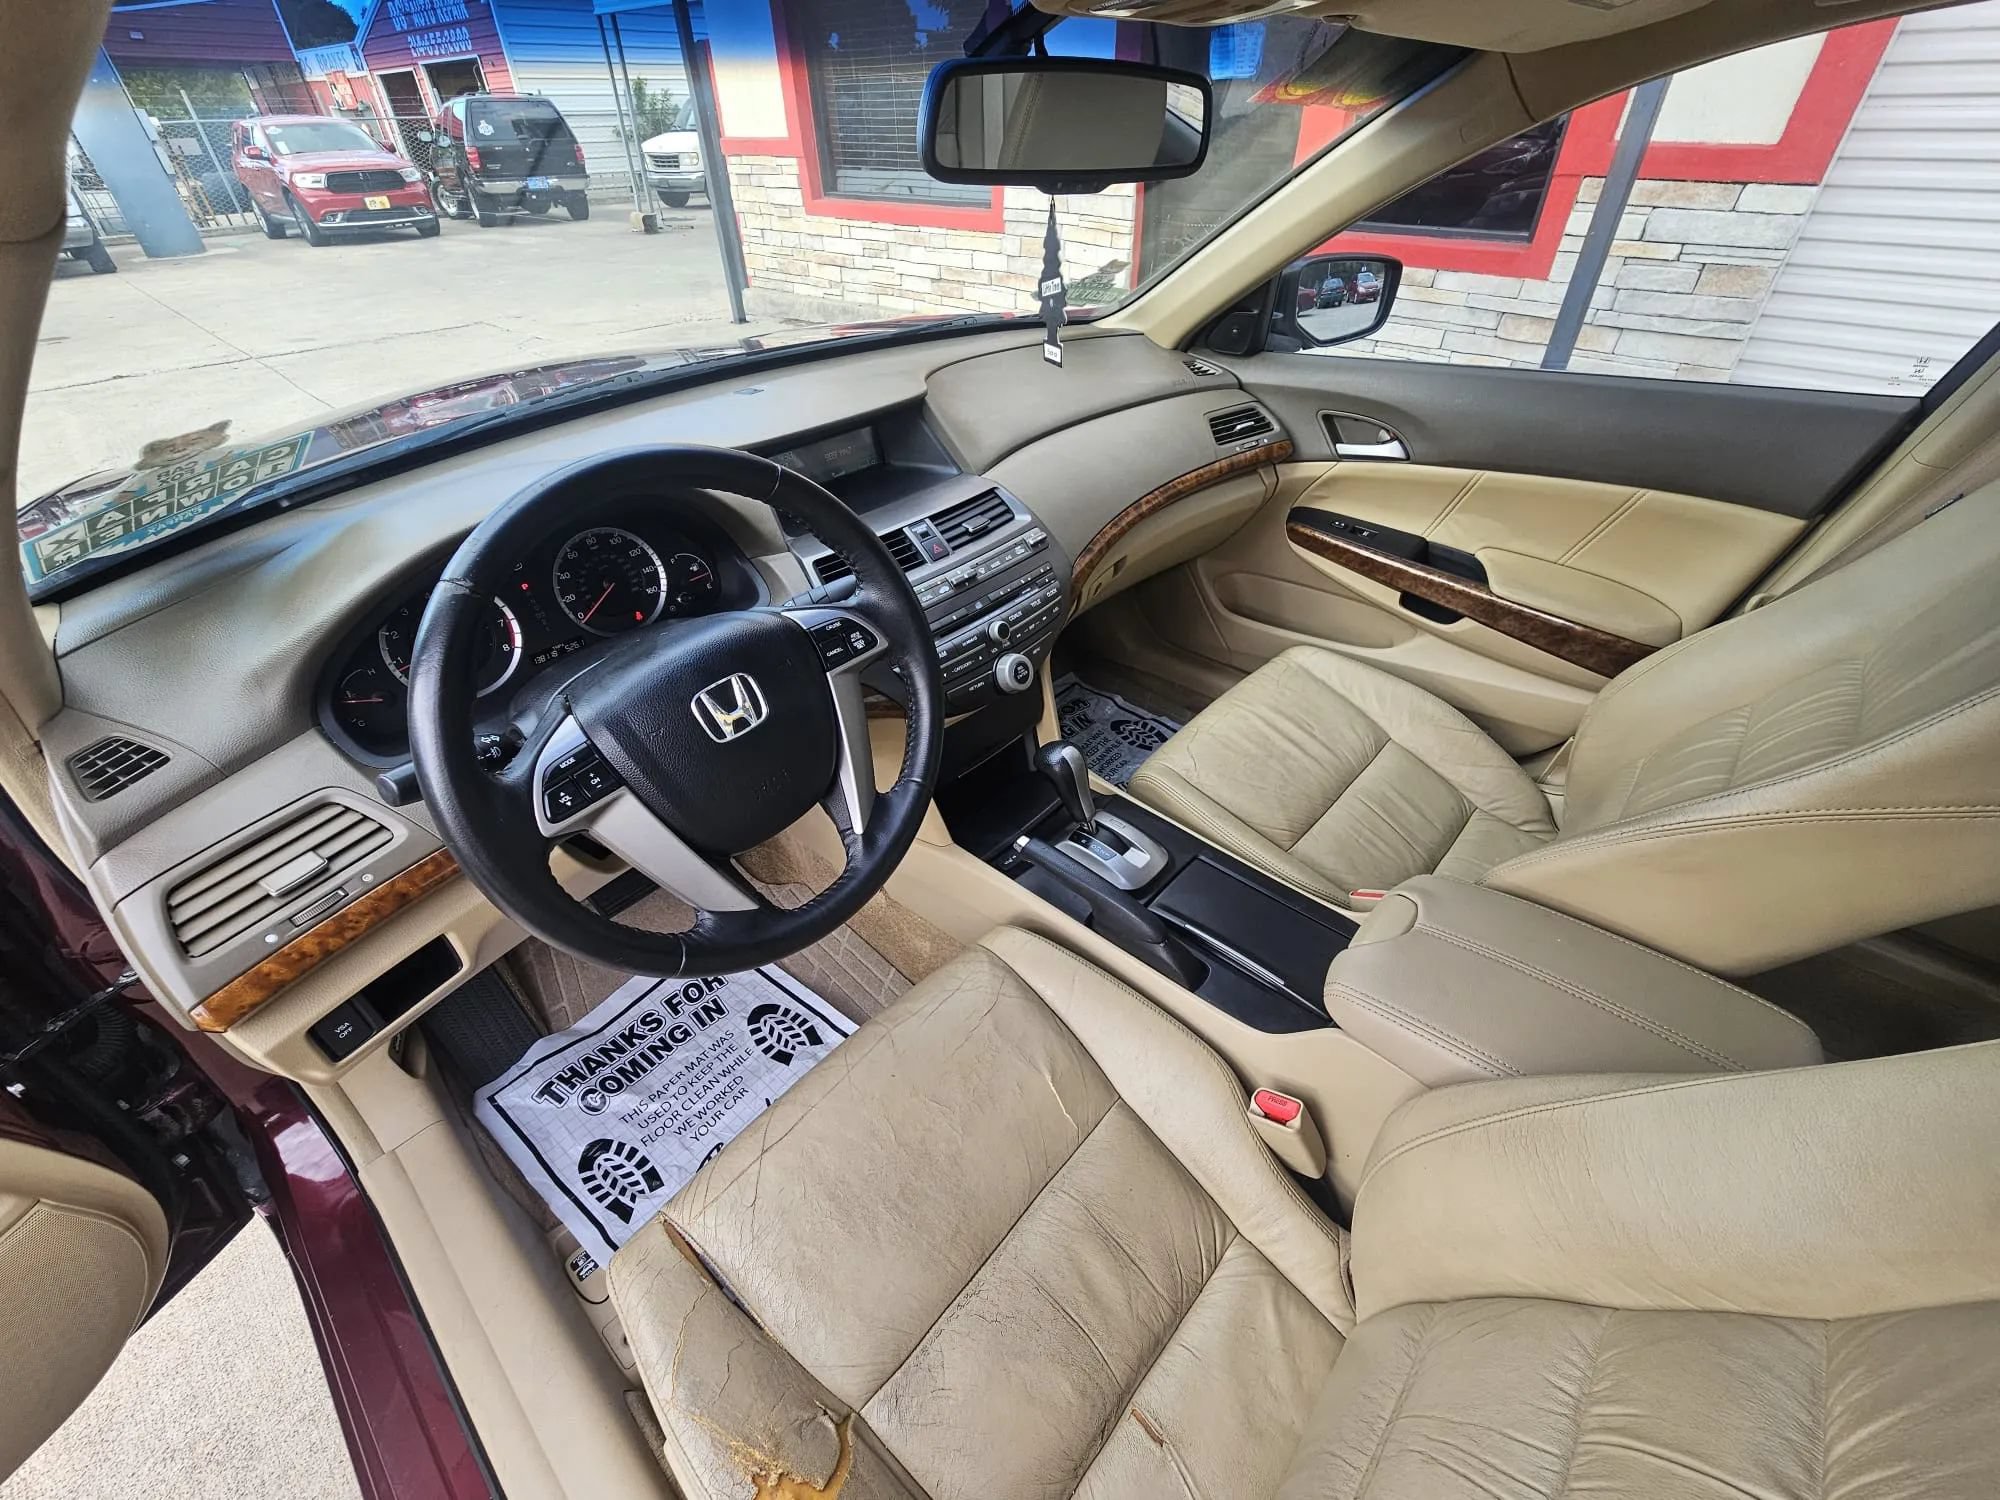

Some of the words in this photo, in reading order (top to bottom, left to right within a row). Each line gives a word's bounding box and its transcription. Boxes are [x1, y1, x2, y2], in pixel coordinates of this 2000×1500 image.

[333, 1022, 350, 1034] VSA
[338, 1026, 353, 1039] OFF
[531, 1010, 667, 1109] THANKS
[577, 1022, 696, 1116] COMING
[688, 995, 729, 1031] IN
[619, 1100, 649, 1124] THIS
[648, 1071, 685, 1102] PAPER
[684, 1050, 709, 1073] MAT
[708, 1030, 734, 1052] WAS
[638, 1101, 672, 1129] USED
[670, 1085, 688, 1101] TO
[688, 1062, 714, 1087] KEEP
[714, 1043, 738, 1063] THE
[640, 1110, 683, 1147] FLOOR
[681, 1076, 720, 1111] CLEAN
[718, 1047, 754, 1078] WHILE
[673, 1117, 696, 1136] WE
[693, 1075, 744, 1120] WORKED
[690, 1110, 725, 1142] YOUR
[724, 1087, 749, 1110] CAR
